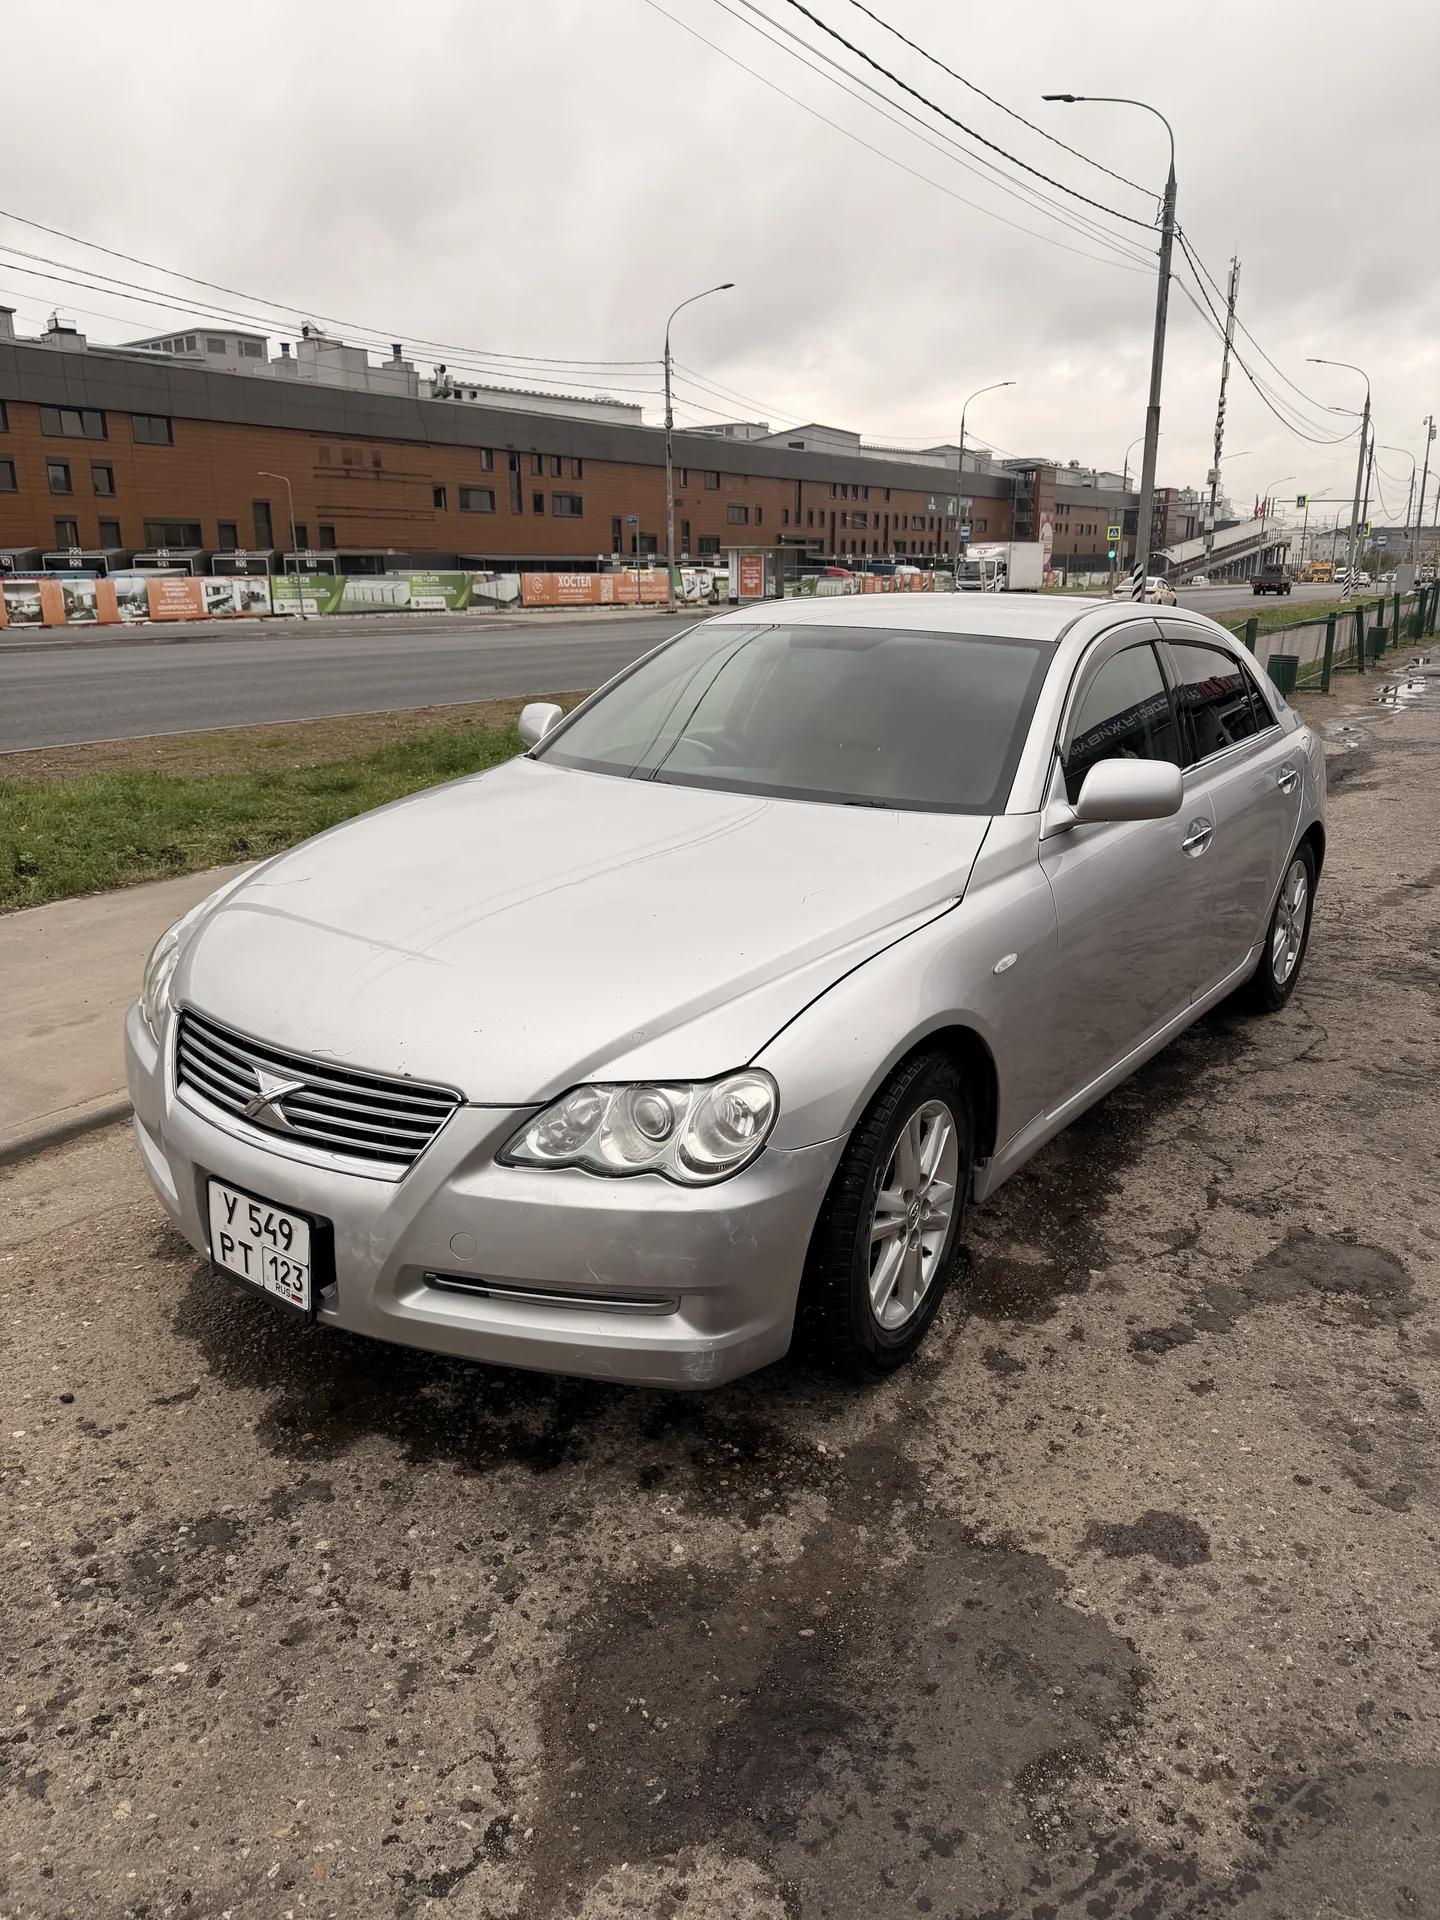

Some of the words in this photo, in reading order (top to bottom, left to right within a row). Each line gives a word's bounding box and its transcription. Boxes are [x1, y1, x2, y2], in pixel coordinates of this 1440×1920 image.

[69, 547, 82, 555] 22
[69, 559, 83, 567] 22
[557, 575, 592, 587] ХОСТЕЛ
[223, 1191, 238, 1225] У
[248, 1203, 293, 1251] 549
[220, 1231, 253, 1274] РТ
[269, 1256, 303, 1292] 123
[275, 1282, 291, 1298] RUS
